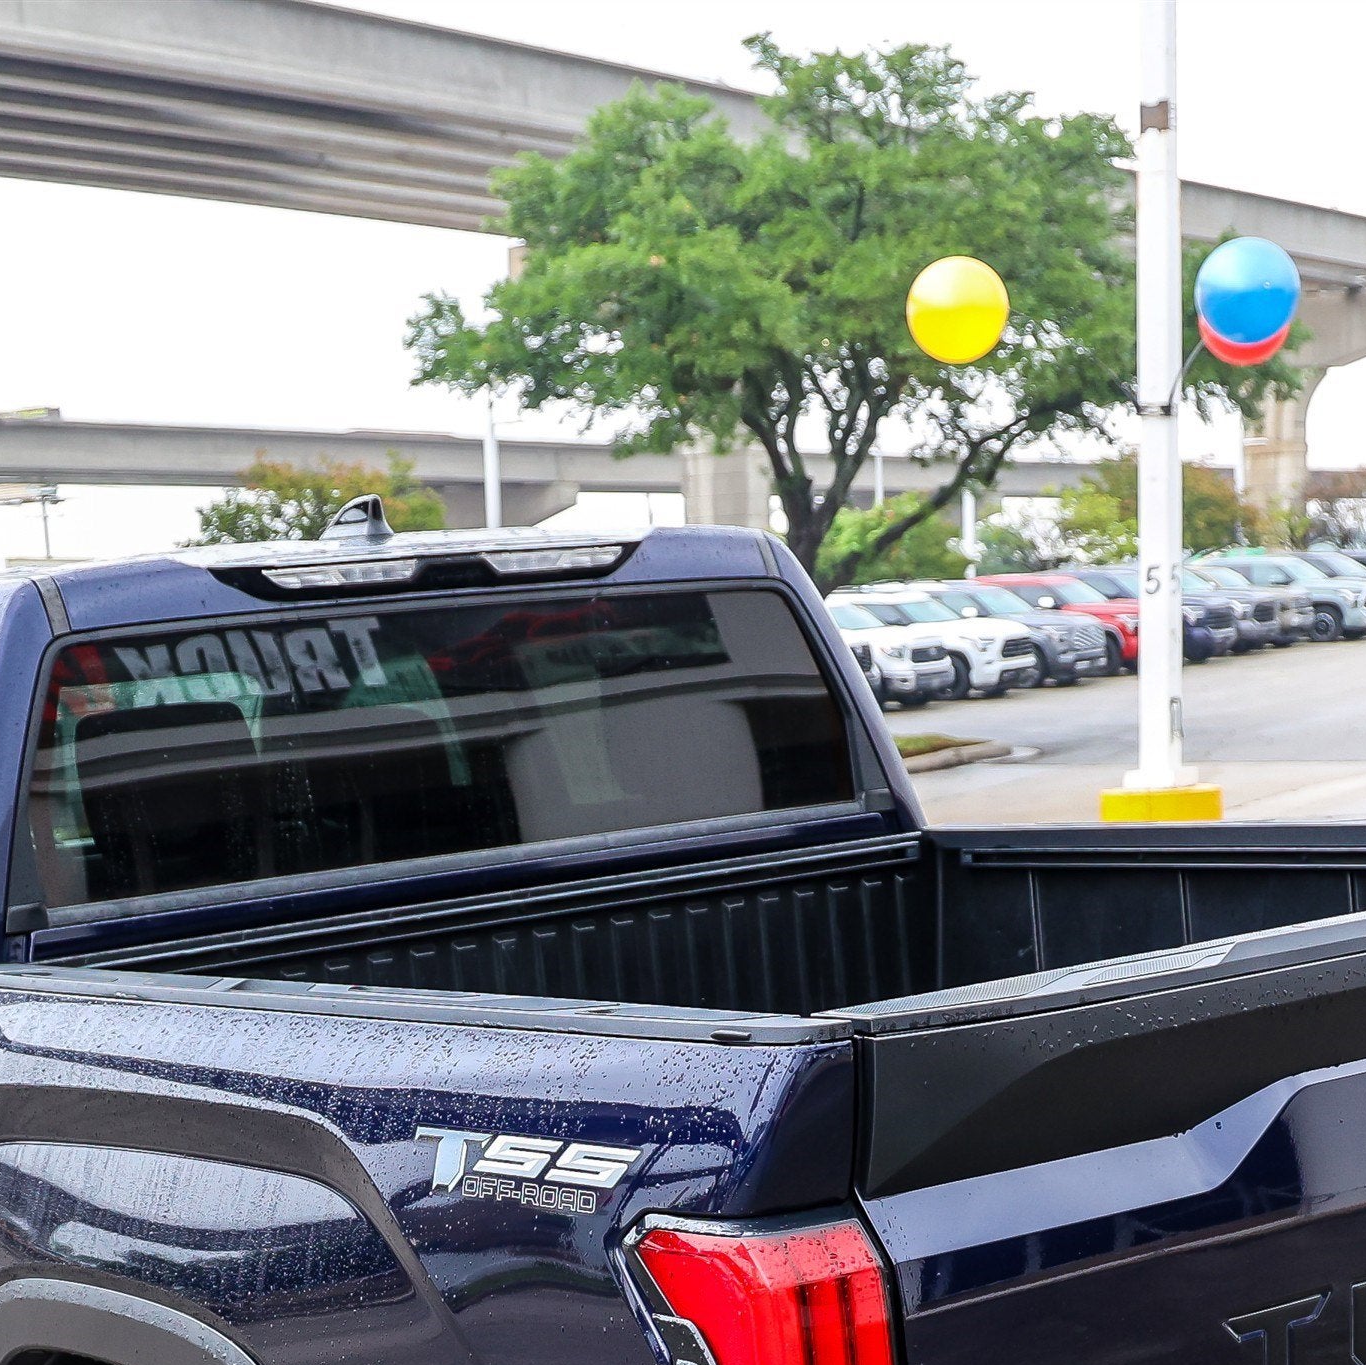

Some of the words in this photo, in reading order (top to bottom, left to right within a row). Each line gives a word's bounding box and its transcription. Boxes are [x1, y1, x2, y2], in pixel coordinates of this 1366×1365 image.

[1145, 565, 1160, 595] 5
[415, 1126, 641, 1192] TSS
[462, 1176, 596, 1213] OFF-ROAD
